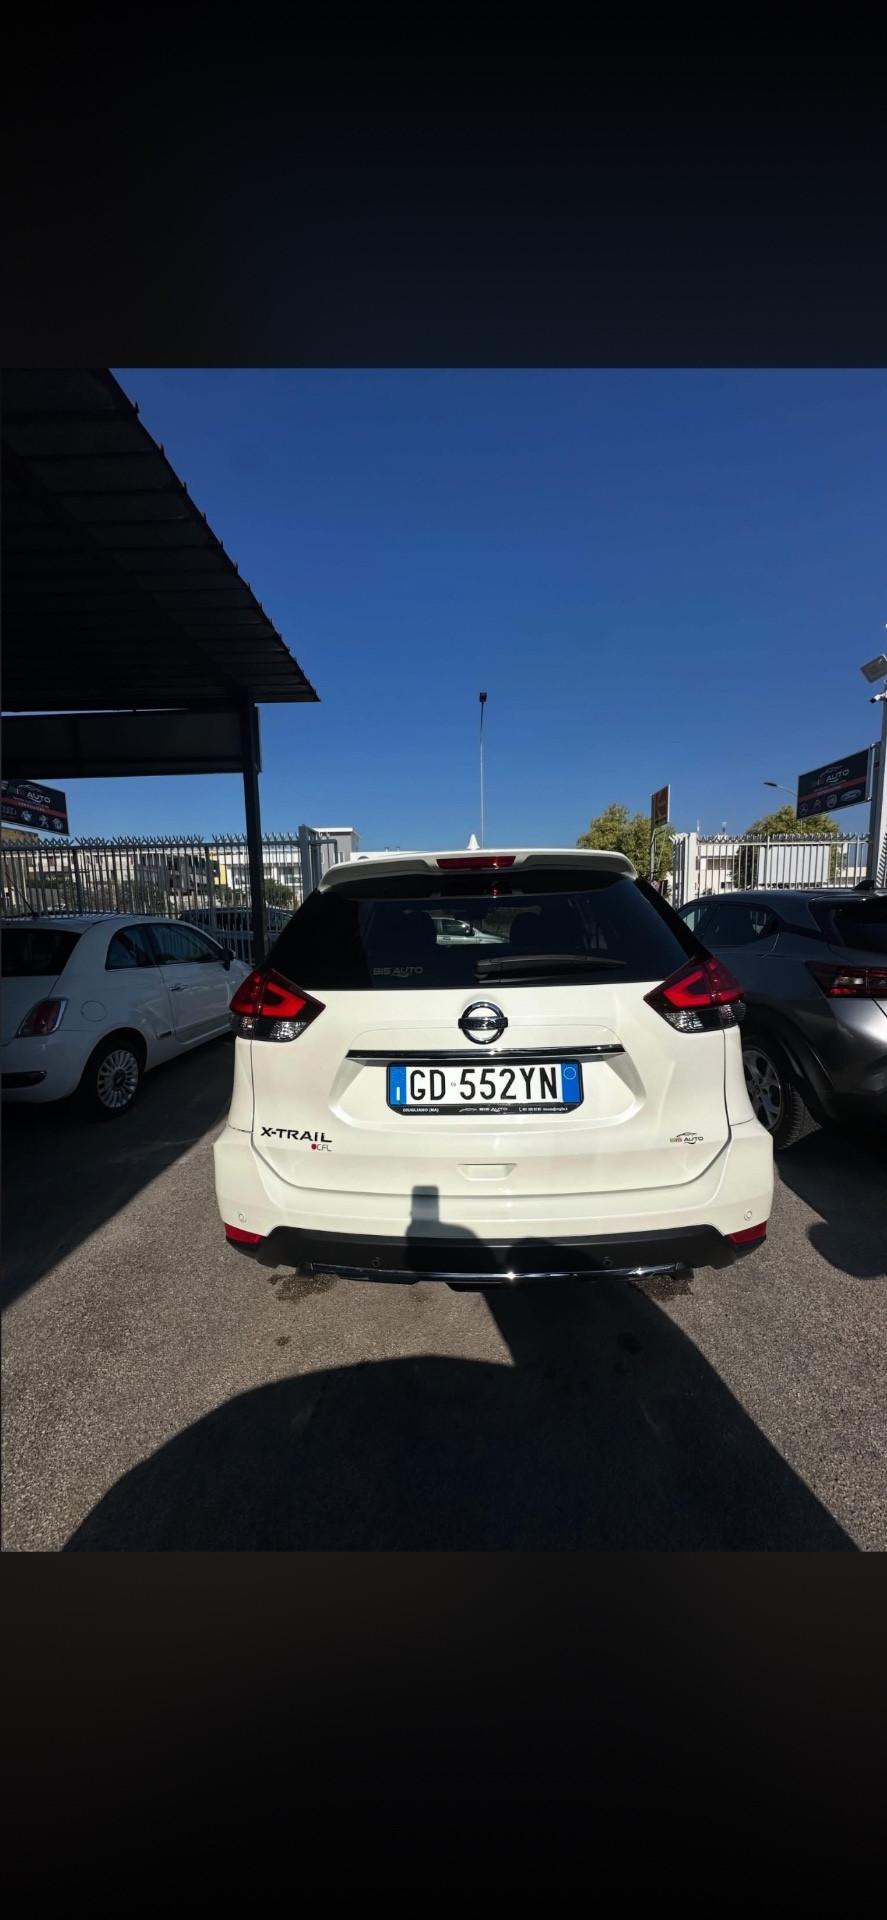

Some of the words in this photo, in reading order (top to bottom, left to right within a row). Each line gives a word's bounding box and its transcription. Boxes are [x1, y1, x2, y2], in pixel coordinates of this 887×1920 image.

[27, 792, 51, 803] AUTO
[390, 966, 424, 977] AUTO
[409, 1069, 446, 1101] GD
[459, 1067, 558, 1100] 552YN
[260, 1126, 333, 1143] X-TRAIL
[316, 1143, 333, 1152] CFL
